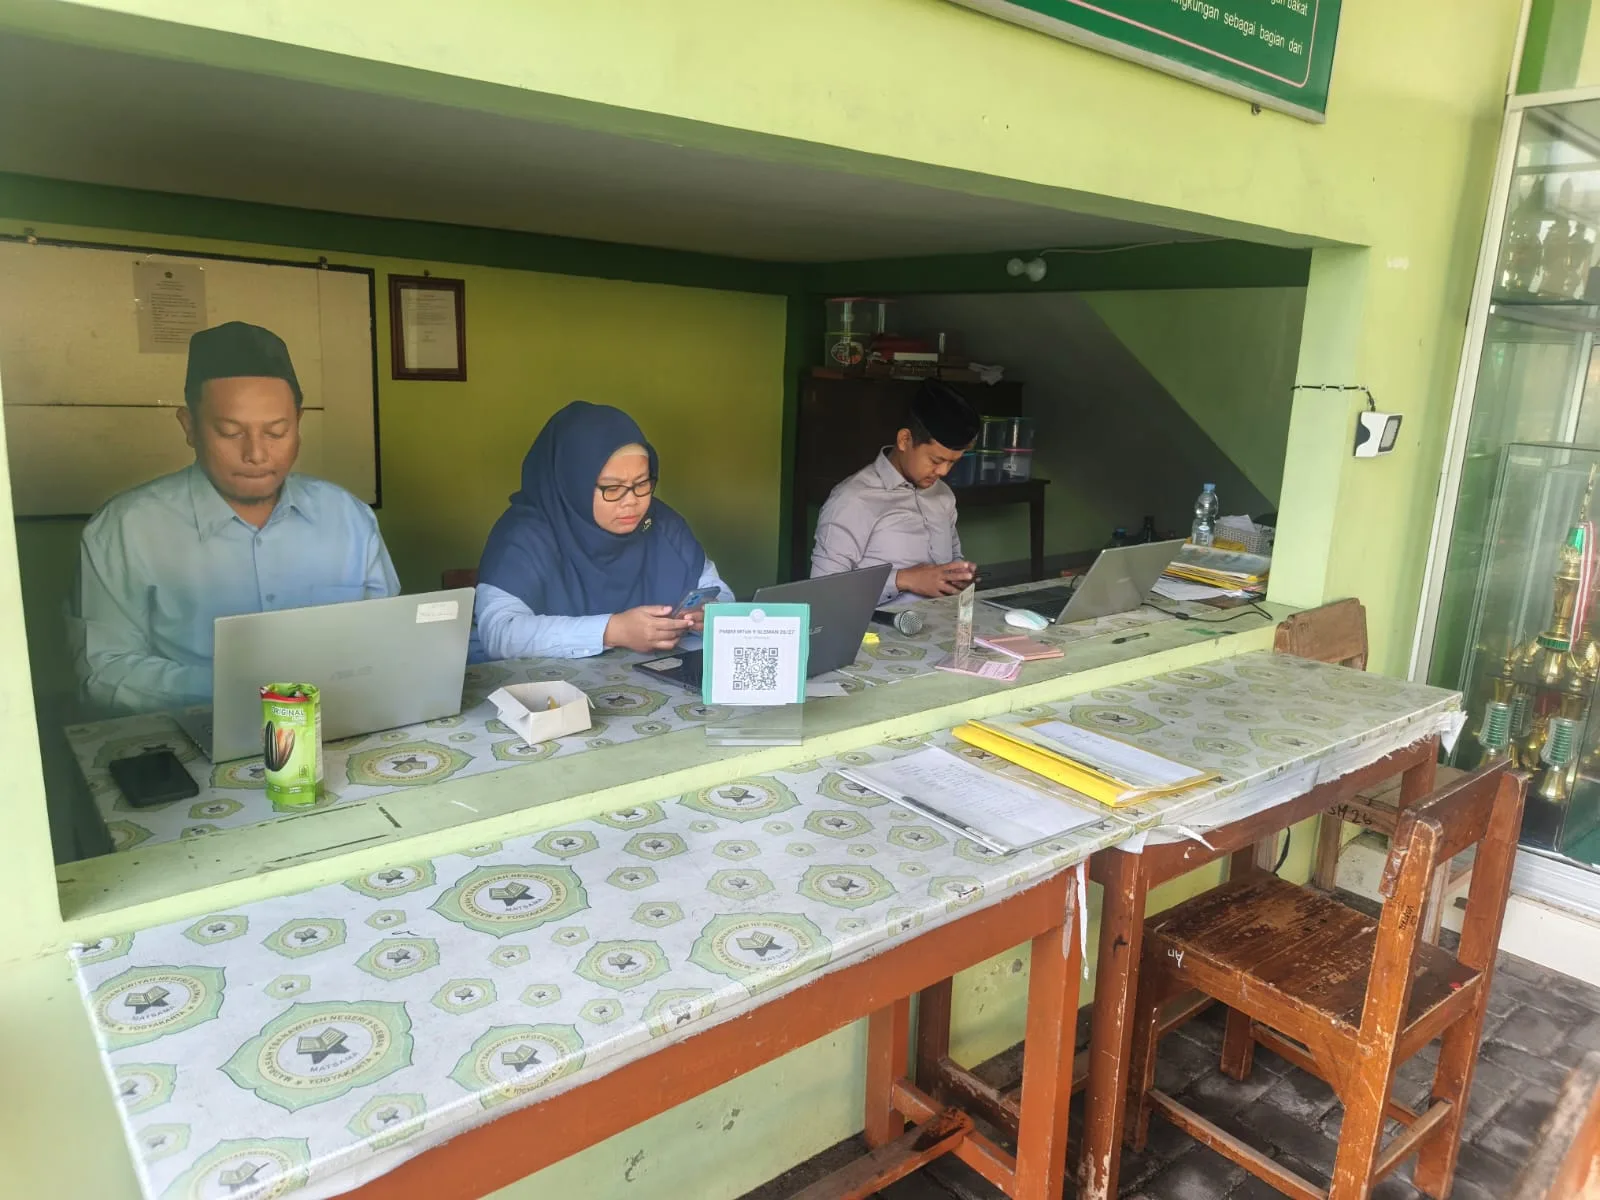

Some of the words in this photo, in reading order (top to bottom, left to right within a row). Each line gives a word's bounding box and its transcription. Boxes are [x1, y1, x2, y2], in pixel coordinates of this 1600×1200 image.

[1170, 0, 1220, 20] gkungan
[1223, 12, 1257, 36] sebagai
[1259, 23, 1285, 48] bagian
[1288, 38, 1304, 56] dari
